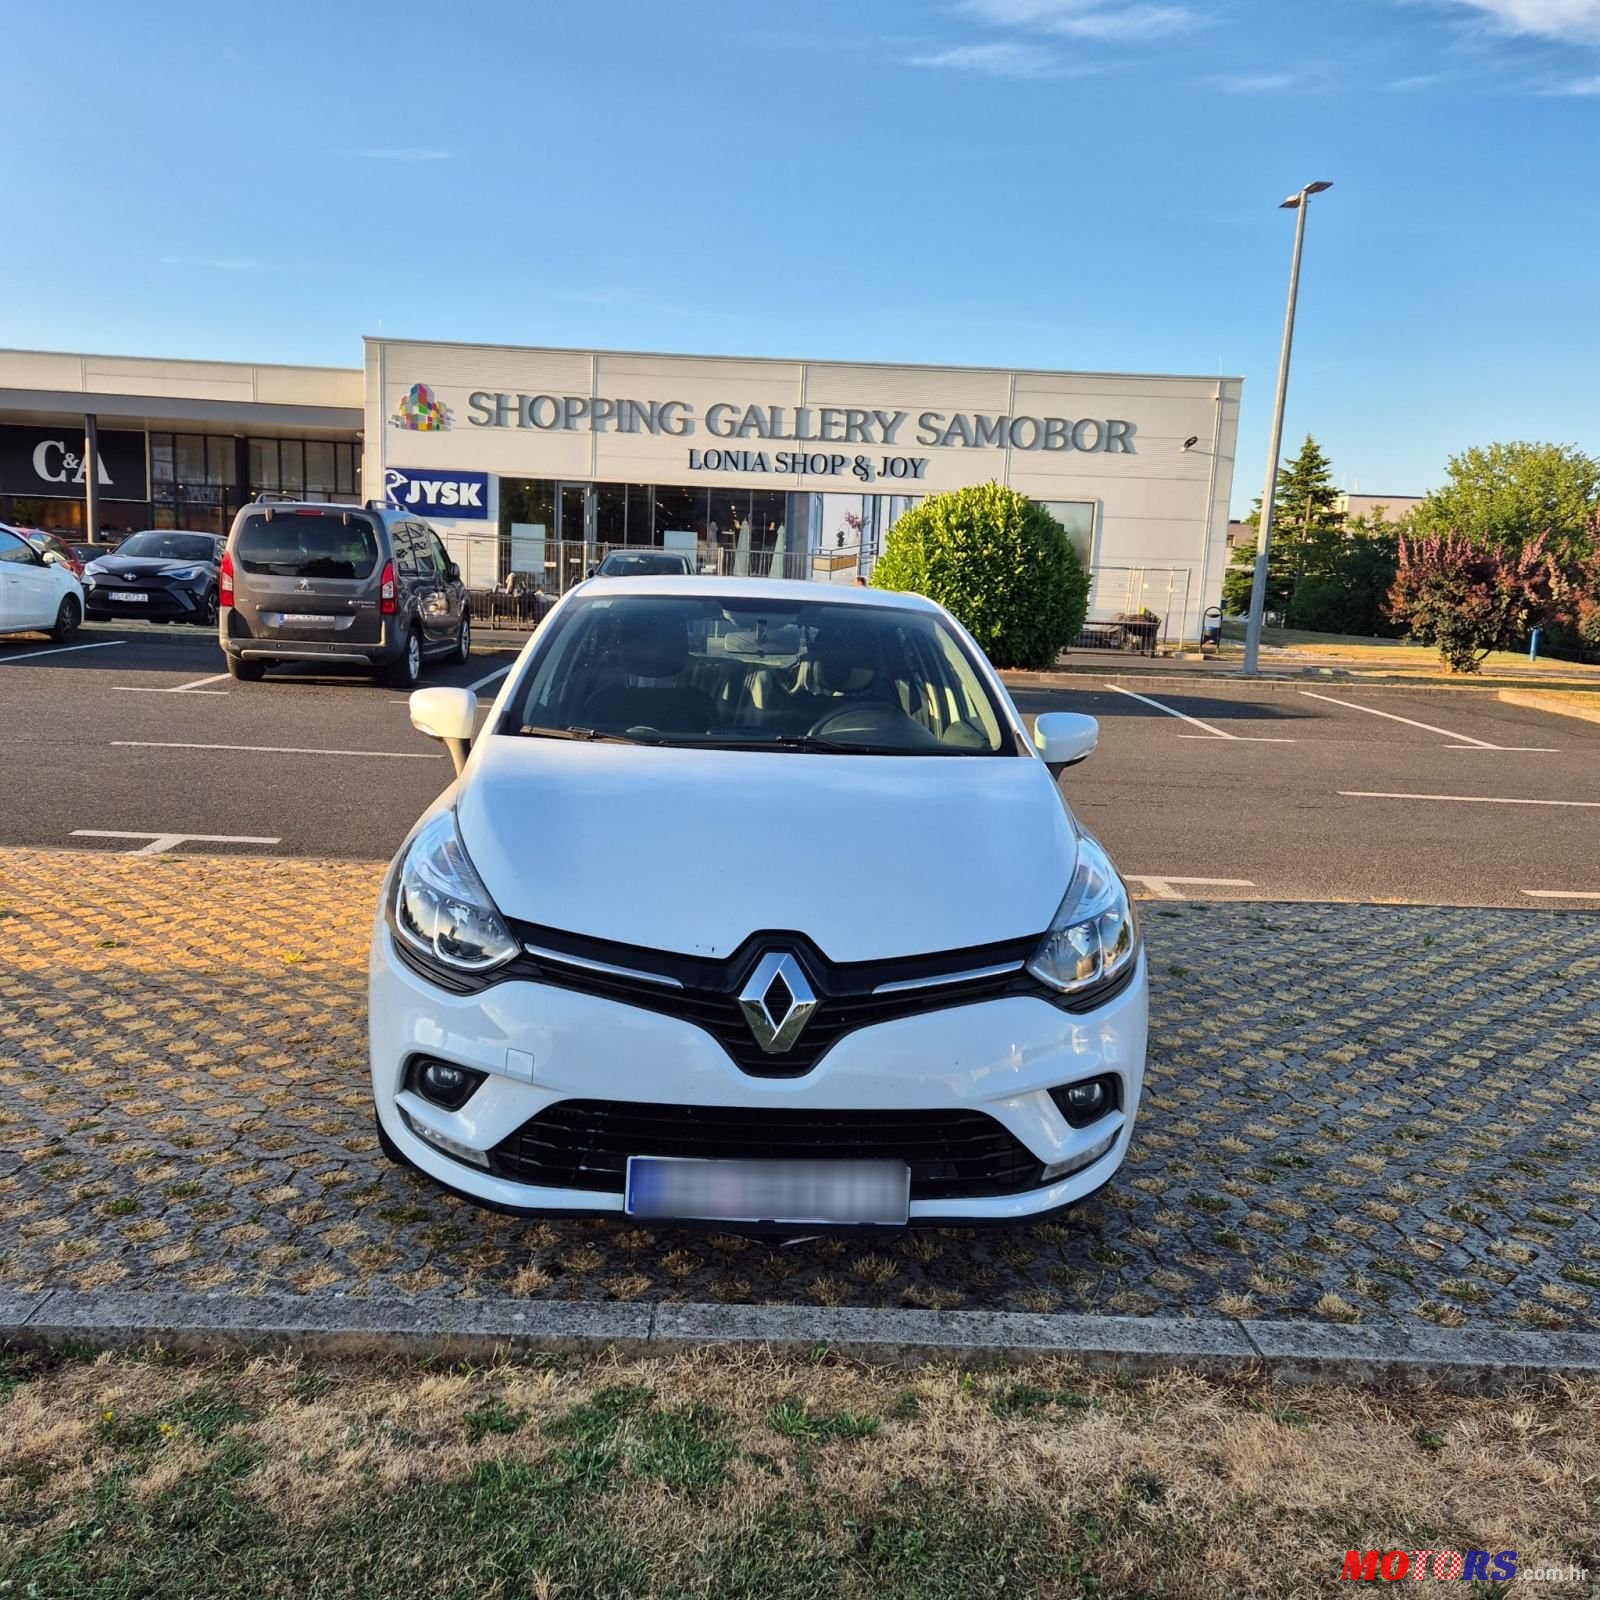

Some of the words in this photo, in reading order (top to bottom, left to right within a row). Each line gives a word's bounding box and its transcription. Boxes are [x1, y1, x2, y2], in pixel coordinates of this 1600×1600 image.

[467, 391, 690, 436] SHOPPING
[705, 402, 903, 445] GALLERY
[915, 412, 1135, 454] SAMOBOR
[687, 448, 767, 473] LONIA
[774, 452, 846, 476] SHOP
[851, 454, 870, 482] &
[877, 456, 926, 479] JOY
[404, 480, 483, 507] JYSK
